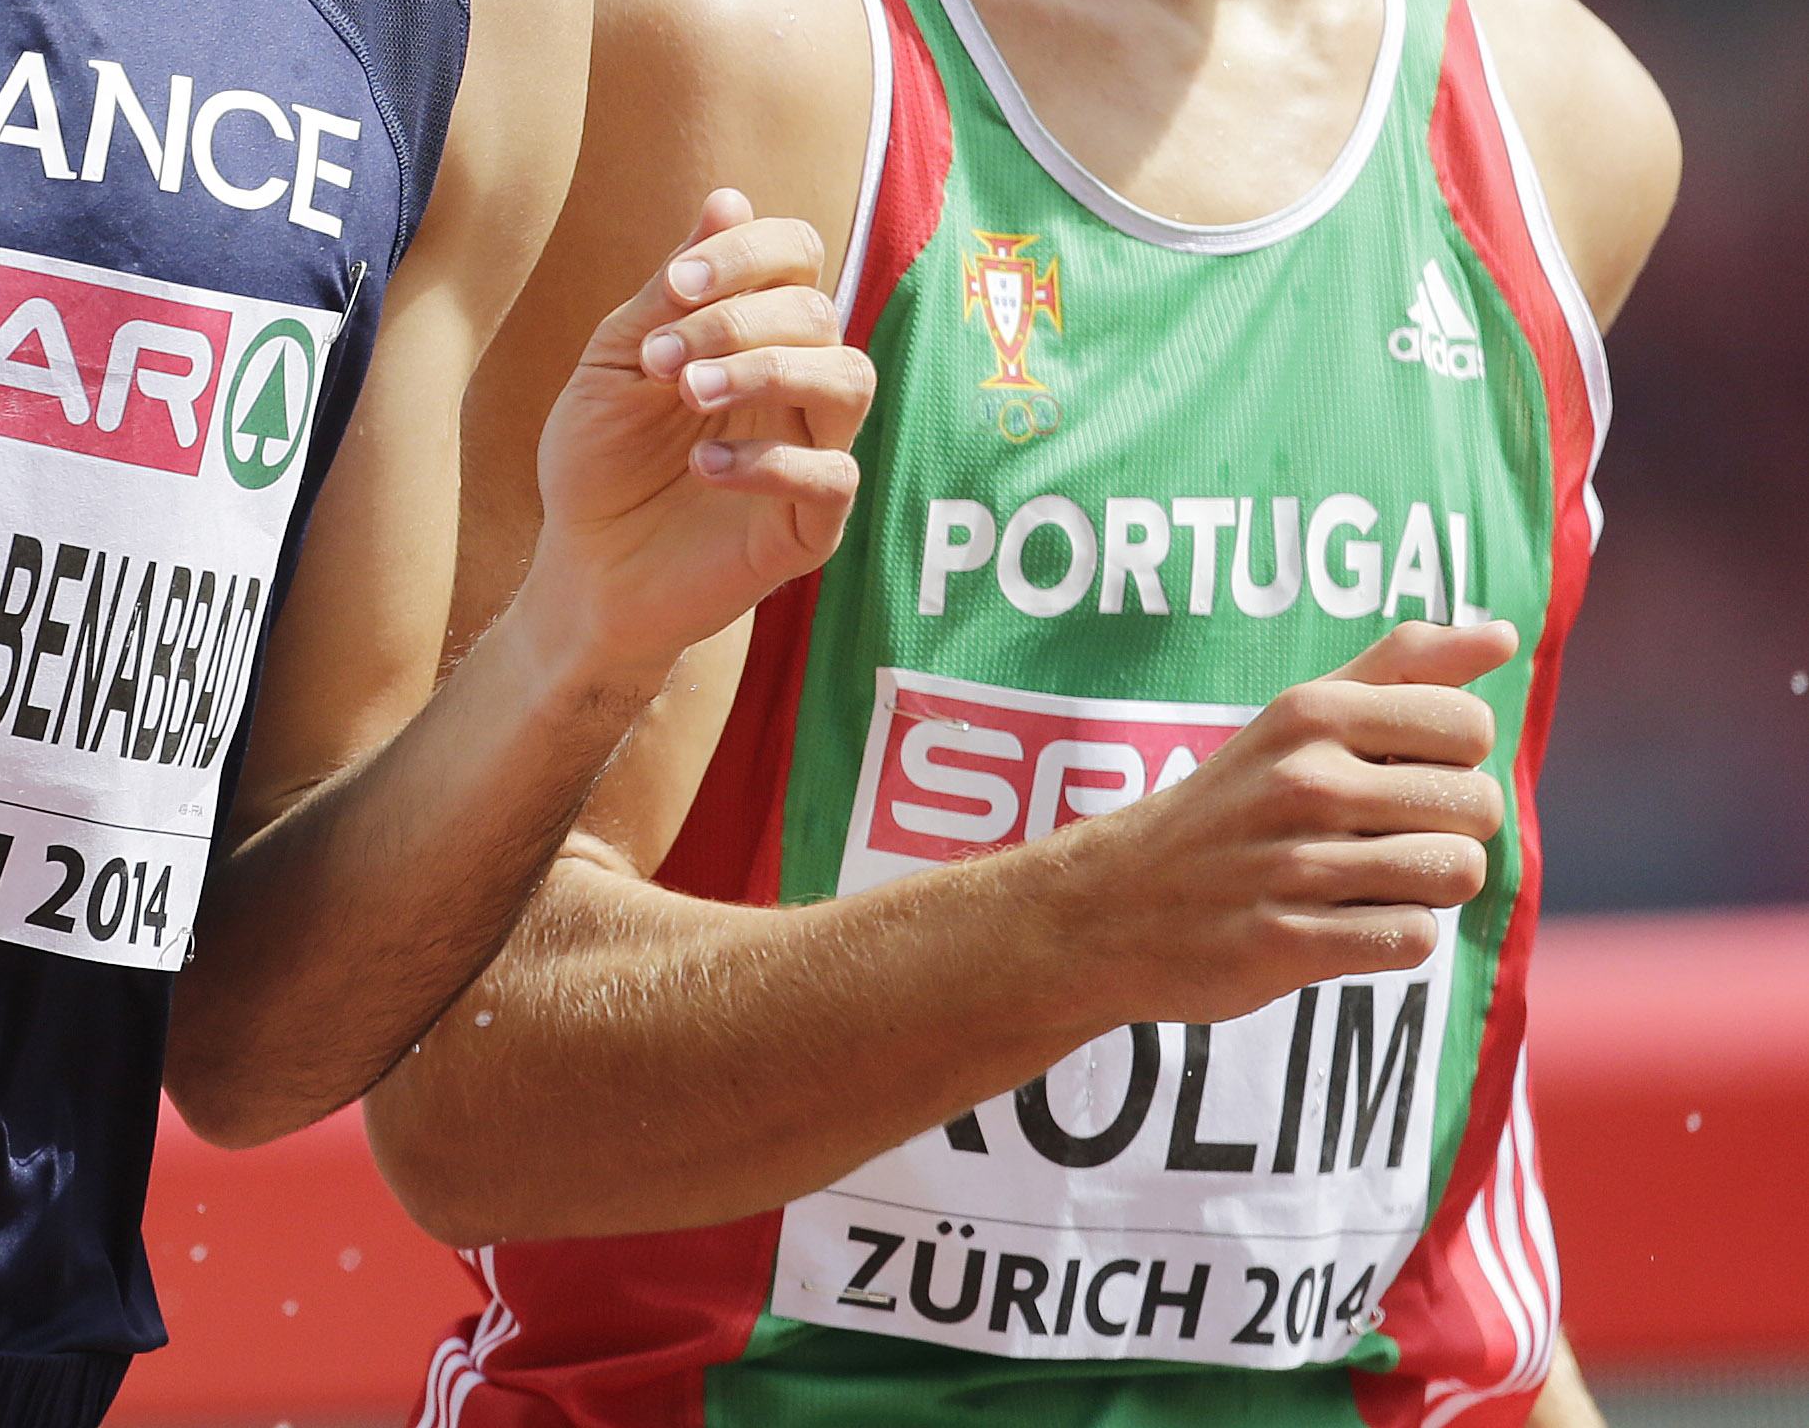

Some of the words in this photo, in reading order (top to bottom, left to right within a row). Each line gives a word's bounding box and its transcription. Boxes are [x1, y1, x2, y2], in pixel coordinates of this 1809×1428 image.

[916, 492, 1491, 629] PORTUGAL
[23, 843, 173, 948] 2014
[939, 980, 1430, 1175] OLIM
[835, 1220, 1213, 1342] ZÜRICH
[1230, 1260, 1377, 1345] 2014
